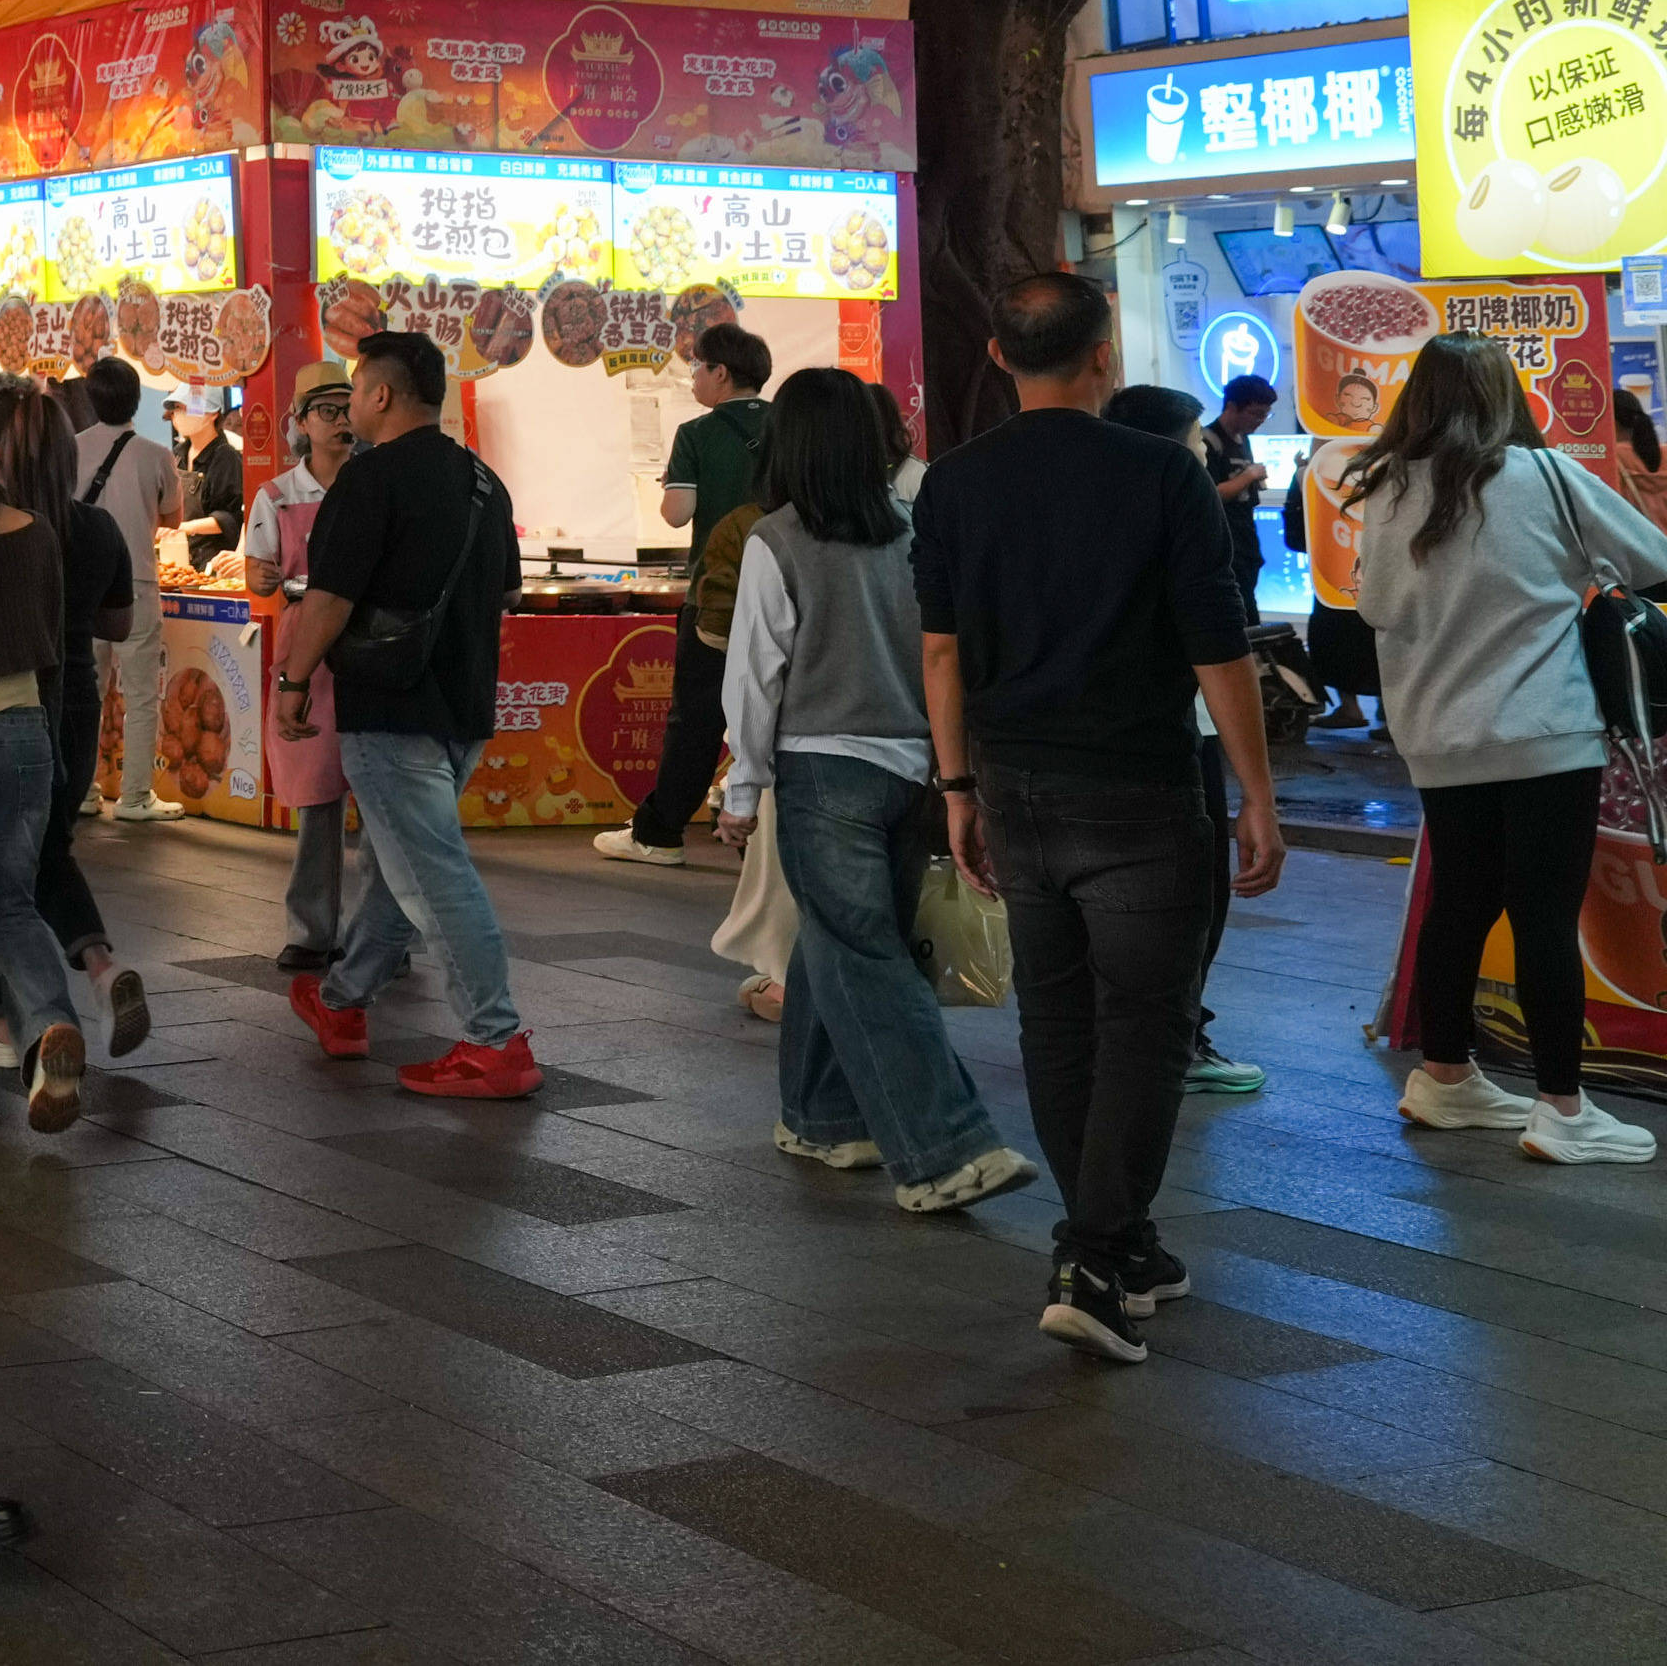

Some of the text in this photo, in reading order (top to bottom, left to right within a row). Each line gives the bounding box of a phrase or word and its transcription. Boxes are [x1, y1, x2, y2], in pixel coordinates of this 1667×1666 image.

[1528, 47, 1620, 102] 以保证
[1200, 69, 1385, 154] 整椰椰
[1395, 67, 1410, 134] COCONUT
[1525, 82, 1645, 148] 口感嫩滑
[111, 196, 156, 228] 高山
[421, 187, 496, 220] 拇指
[723, 194, 791, 227] 高山
[101, 228, 171, 262] 小土豆
[412, 222, 511, 259] 生煎包
[704, 231, 811, 263] 小土豆
[386, 281, 477, 311] 火山石
[609, 293, 663, 323] 铁板
[1447, 294, 1578, 330] 招牌椰奶
[167, 302, 212, 336] 拇指
[404, 313, 464, 346] 烤肠
[604, 322, 675, 349] 香豆腐
[161, 331, 220, 366] 生煎包
[495, 710, 538, 727] 食区
[232, 776, 254, 795] Nice
